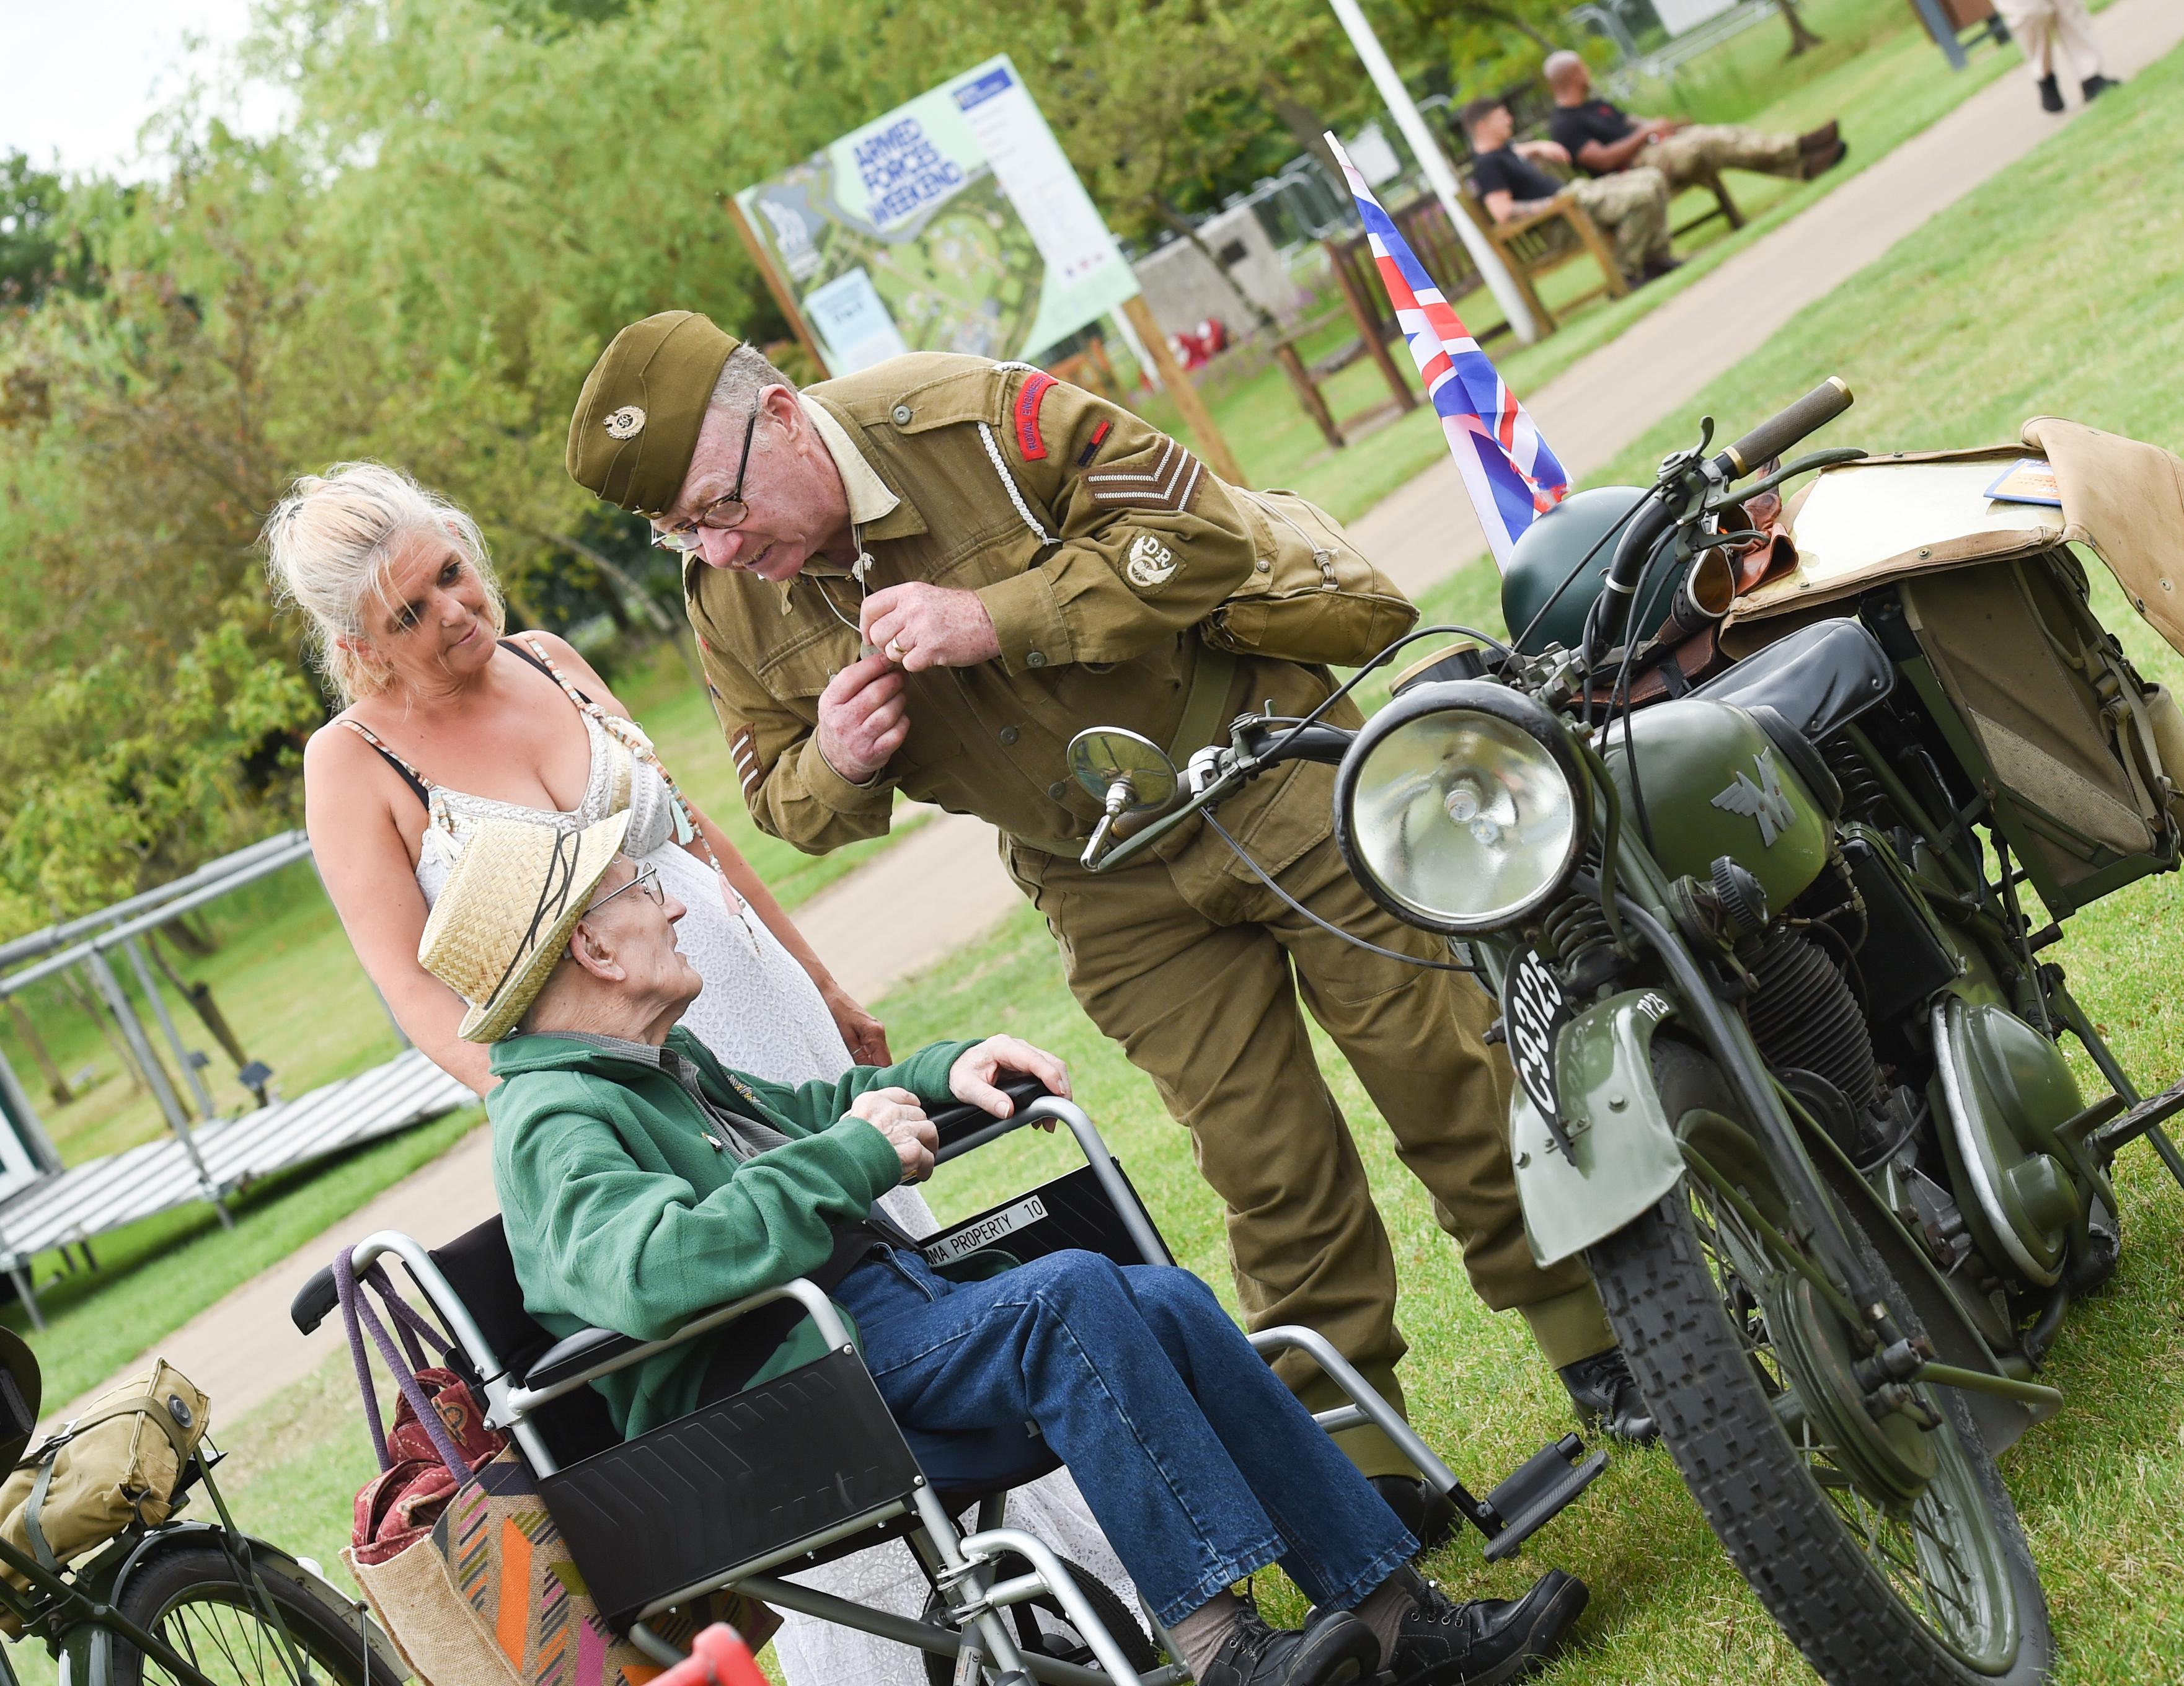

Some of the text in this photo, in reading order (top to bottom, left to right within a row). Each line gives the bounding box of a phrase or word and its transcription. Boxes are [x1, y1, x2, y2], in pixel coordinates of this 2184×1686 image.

[854, 118, 921, 167] ARMED
[863, 141, 939, 188] FORCES
[867, 162, 960, 226] WEEKEND
[1021, 419, 1038, 451] ROYAL
[1513, 949, 1562, 1114] C93125
[950, 1213, 1012, 1255] PROPERTY
[1023, 1199, 1043, 1219] 10
